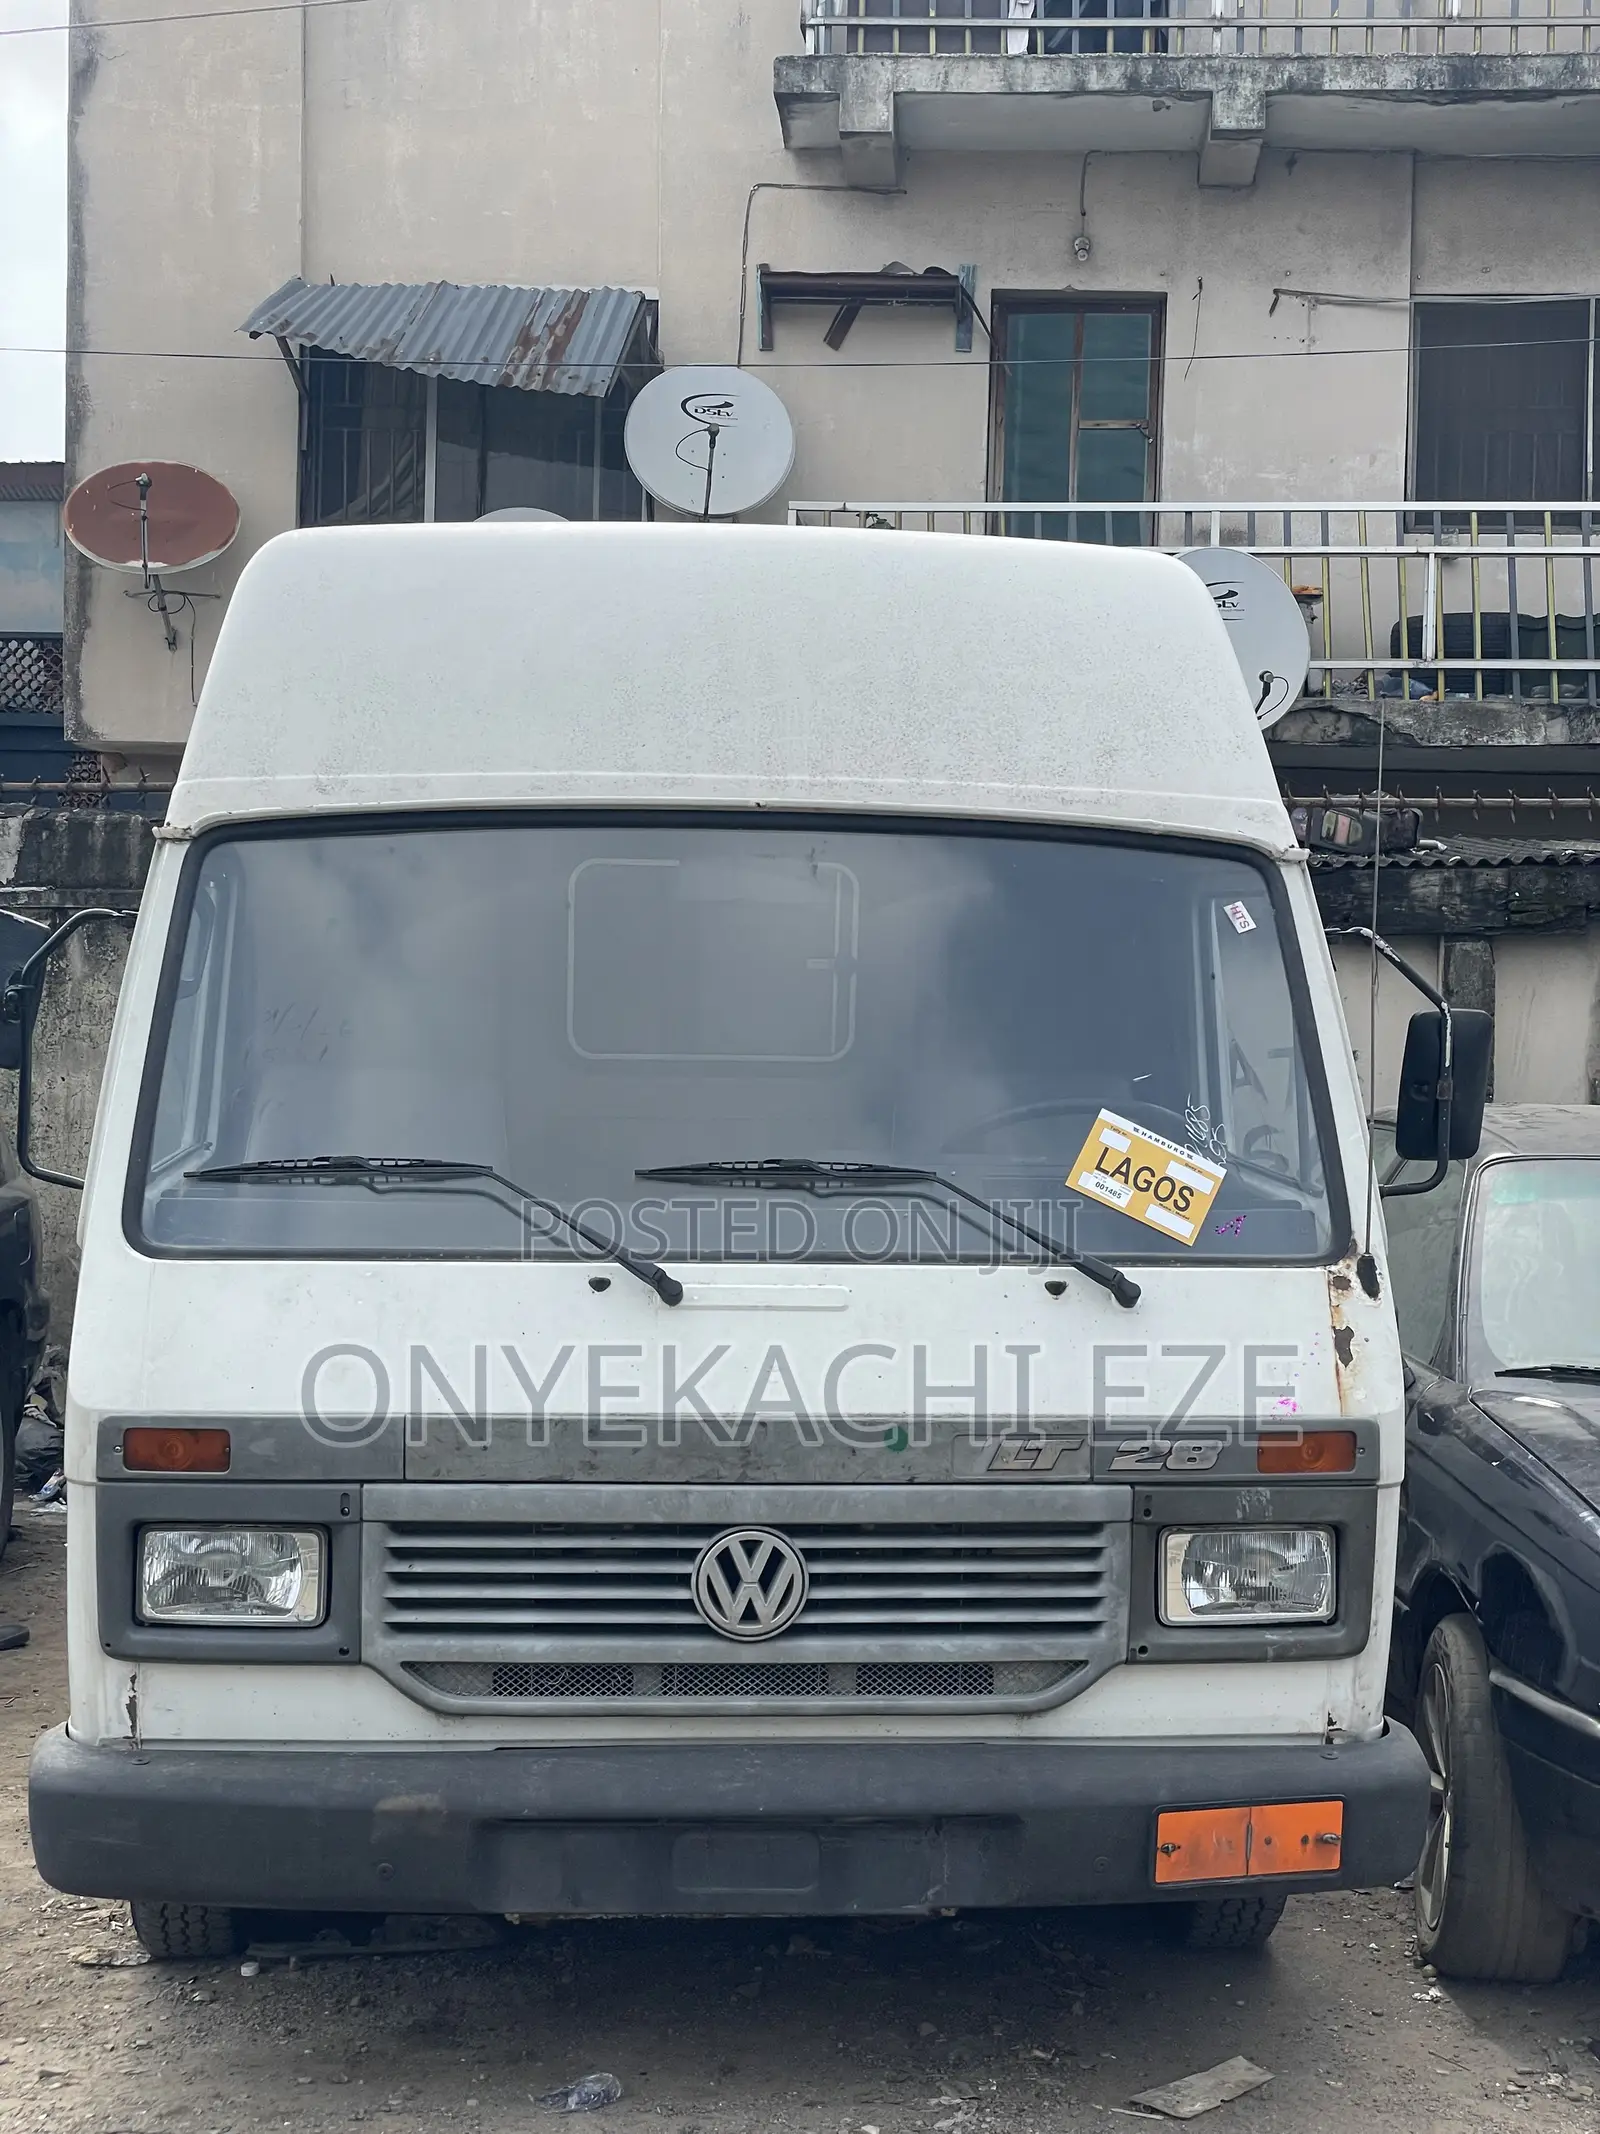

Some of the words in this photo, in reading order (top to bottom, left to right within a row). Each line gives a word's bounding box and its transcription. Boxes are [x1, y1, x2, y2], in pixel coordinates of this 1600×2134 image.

[1094, 1147, 1195, 1213] LAGOS
[1095, 1181, 1122, 1200] 001485
[987, 1439, 1085, 1471] LT
[1107, 1439, 1224, 1471] 28
[698, 1531, 803, 1635] VW
